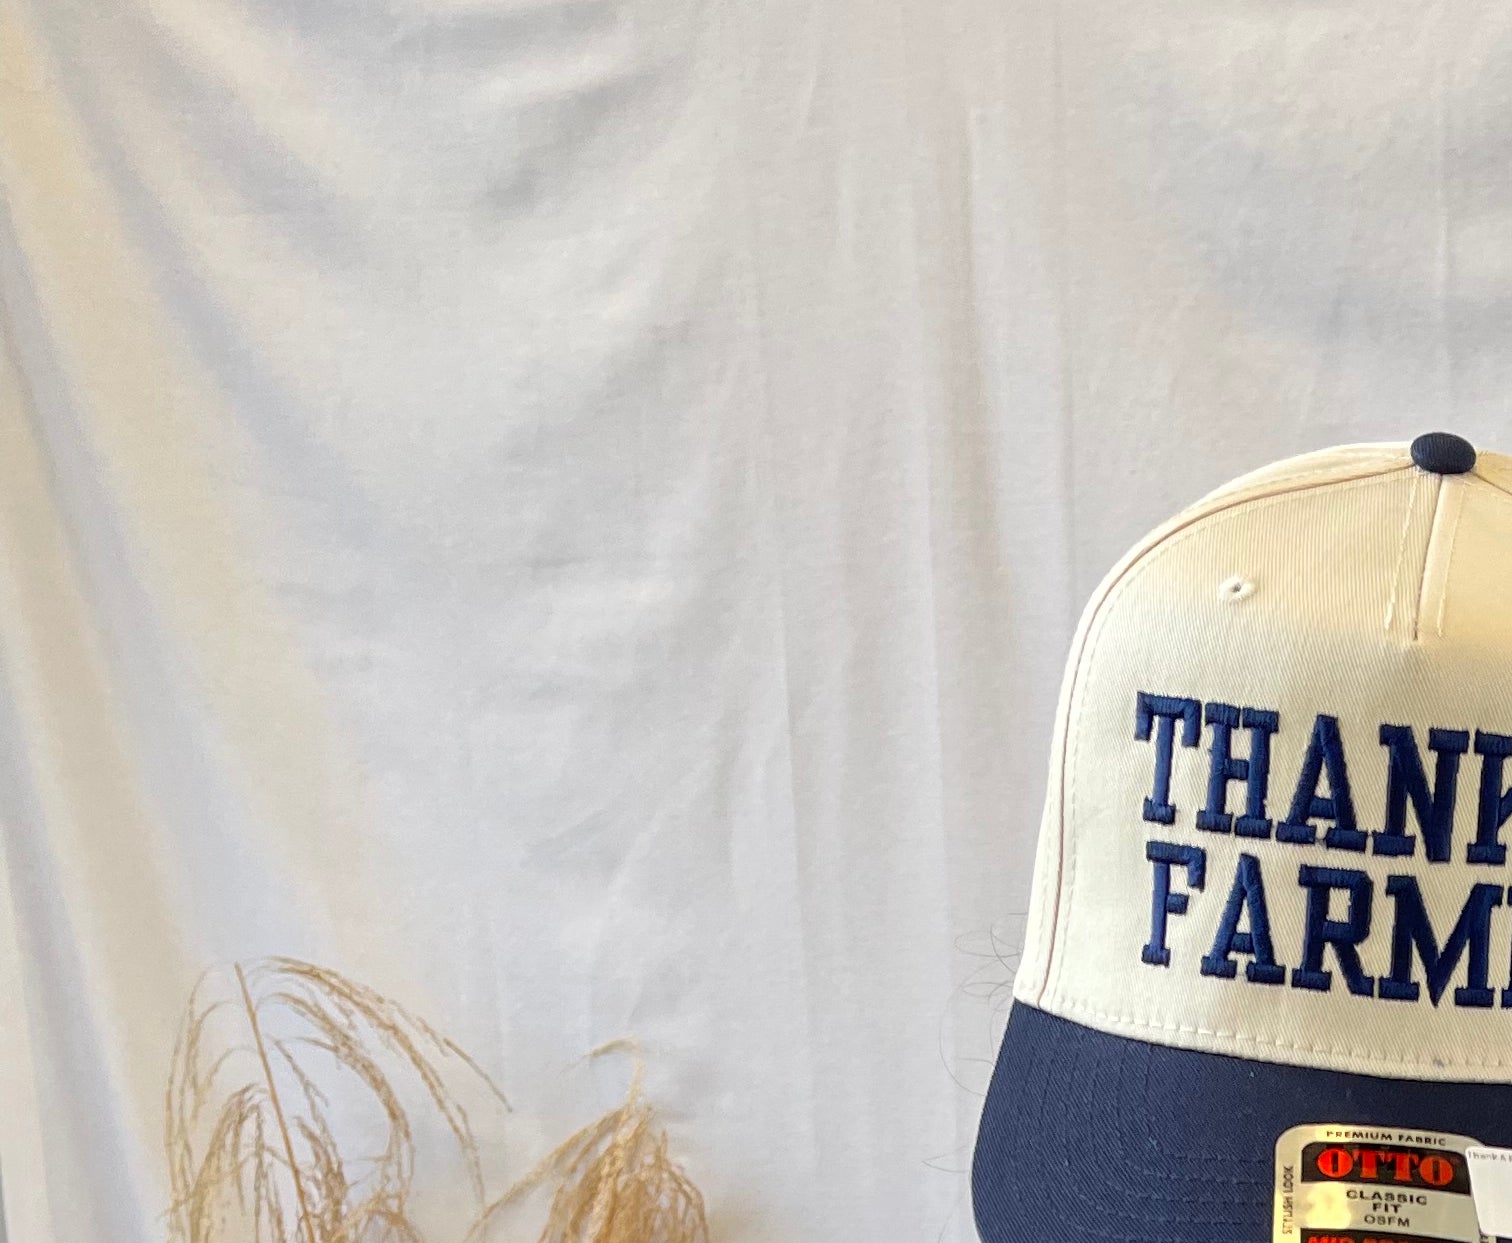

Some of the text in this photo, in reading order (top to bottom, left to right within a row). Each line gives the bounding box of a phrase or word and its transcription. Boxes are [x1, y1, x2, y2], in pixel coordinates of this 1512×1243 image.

[1326, 1130, 1446, 1147] PREMIUM FABRIC
[1316, 1147, 1454, 1186] OTTO
[1283, 1165, 1294, 1194] LOOK
[1346, 1190, 1427, 1206] CLASSIC
[1372, 1202, 1401, 1213] FIT
[1363, 1214, 1410, 1228] OSFM
